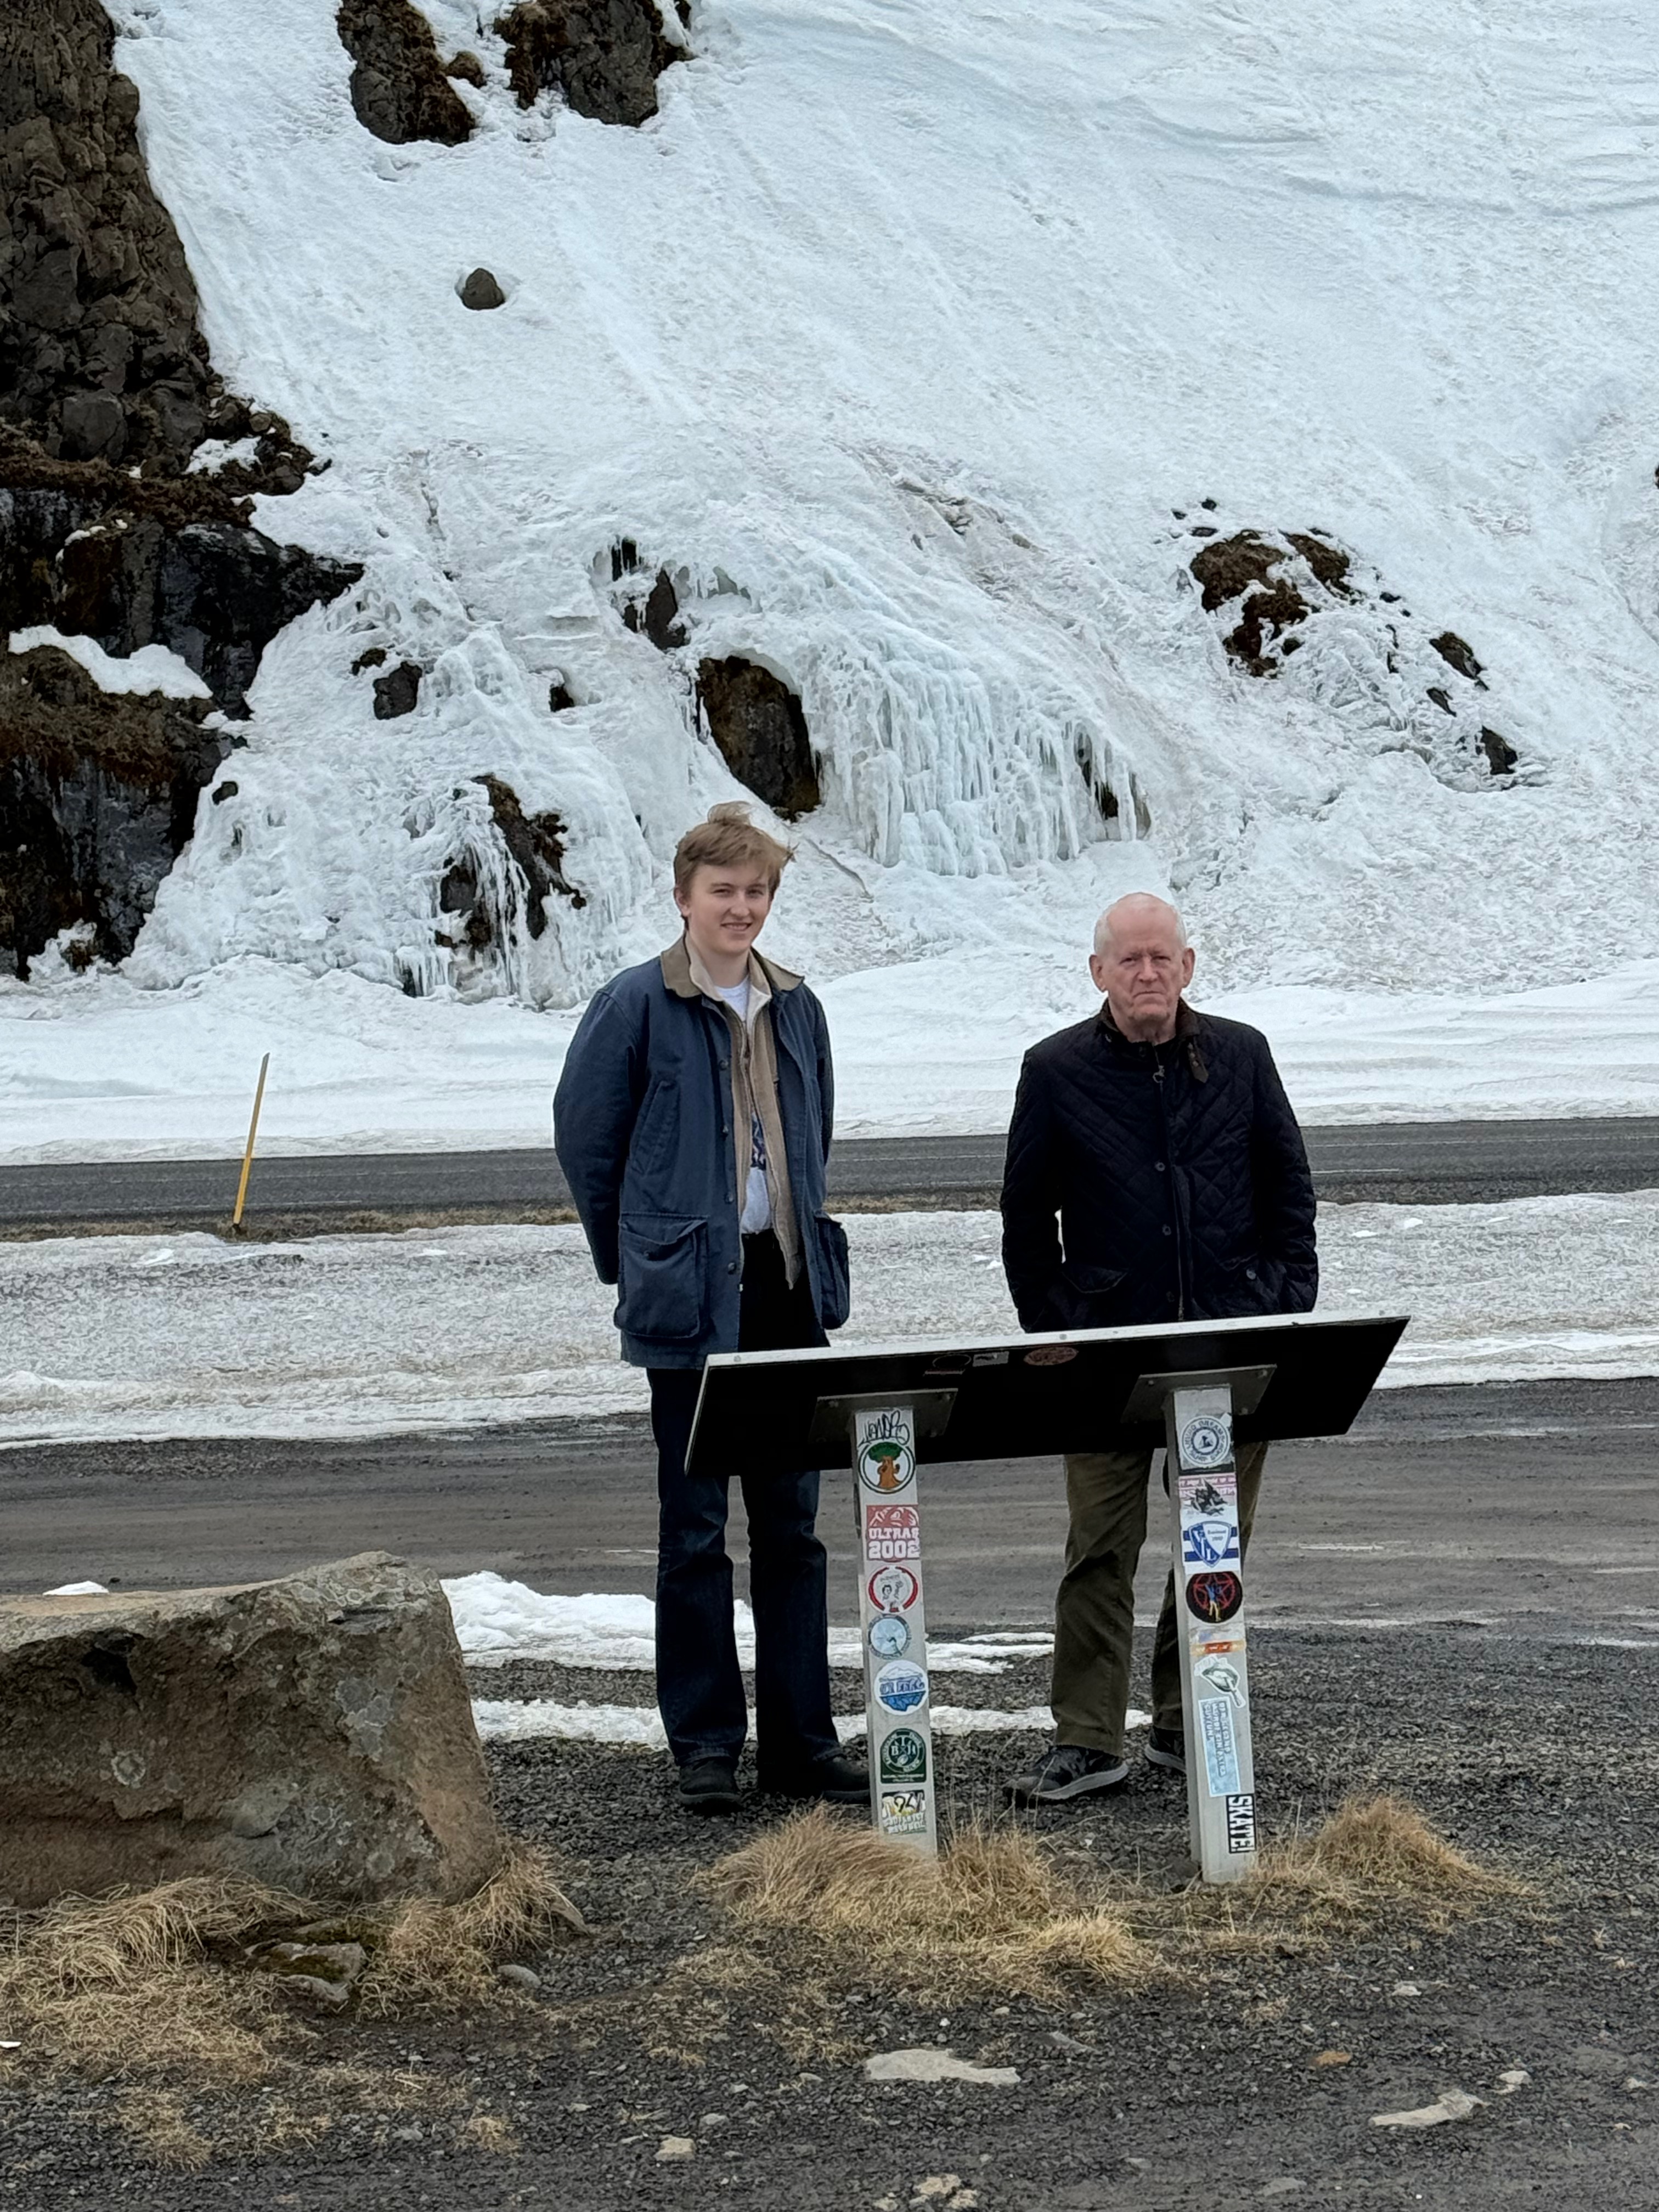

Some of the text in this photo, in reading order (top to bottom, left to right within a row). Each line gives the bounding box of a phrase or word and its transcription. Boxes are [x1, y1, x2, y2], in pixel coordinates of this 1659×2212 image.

[868, 1527, 919, 1539] ULTRAS
[868, 1540, 920, 1559] 2002
[1228, 1796, 1256, 1852] SKATE!
